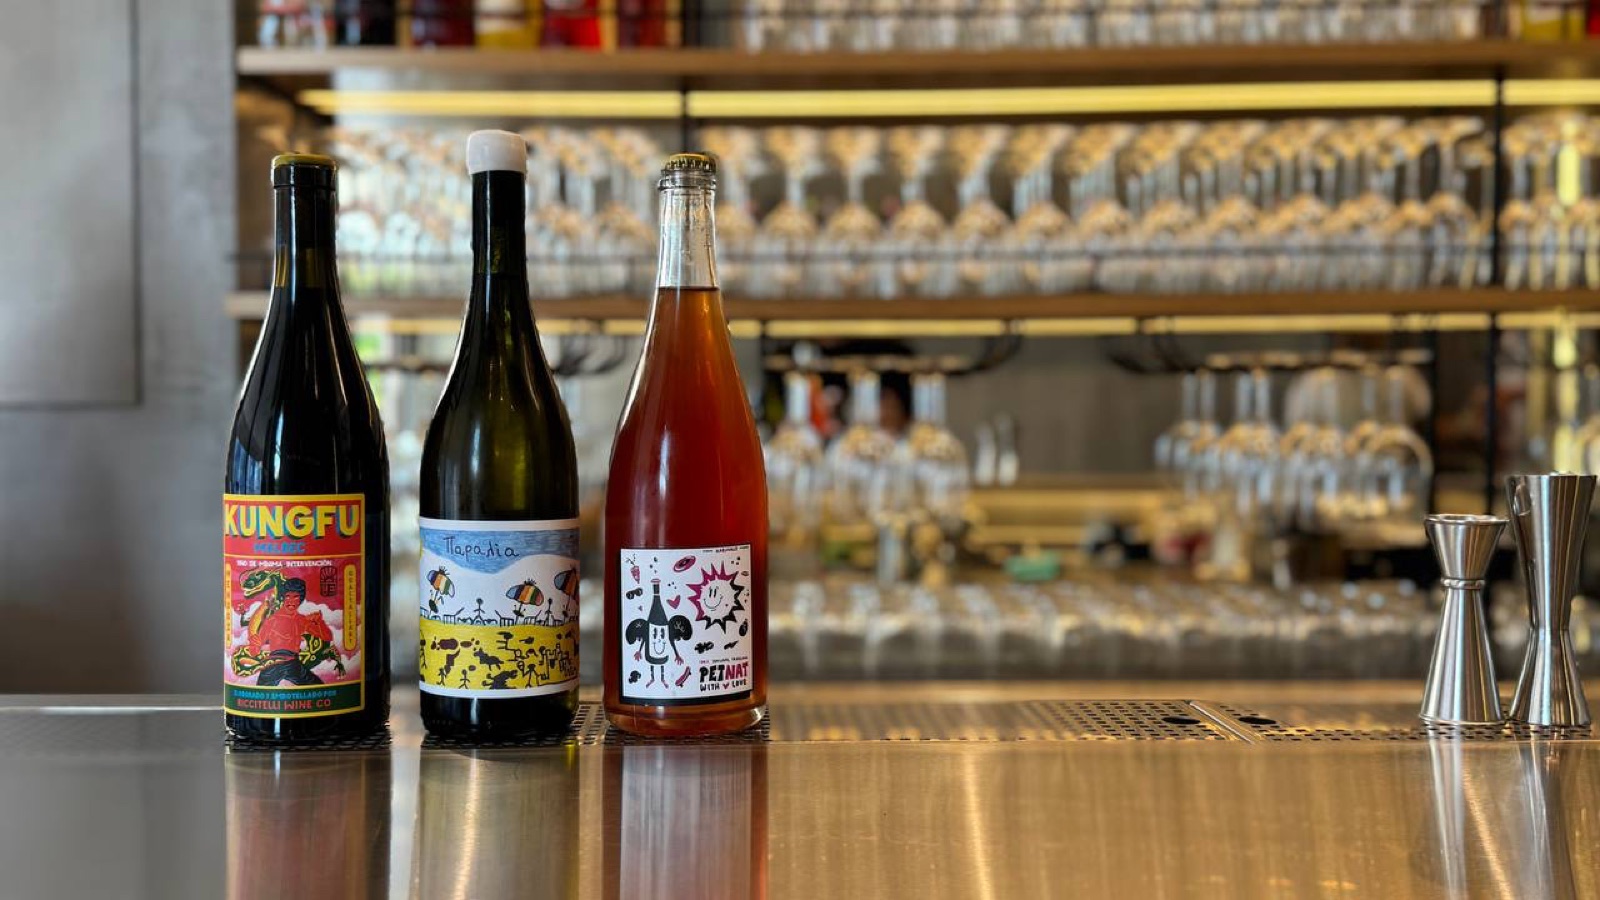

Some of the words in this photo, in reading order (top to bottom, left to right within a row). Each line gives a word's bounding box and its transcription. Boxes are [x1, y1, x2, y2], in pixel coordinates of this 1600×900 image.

[225, 503, 360, 539] KUNGFU
[699, 683, 720, 692] WITH
[283, 699, 312, 710] WINE
